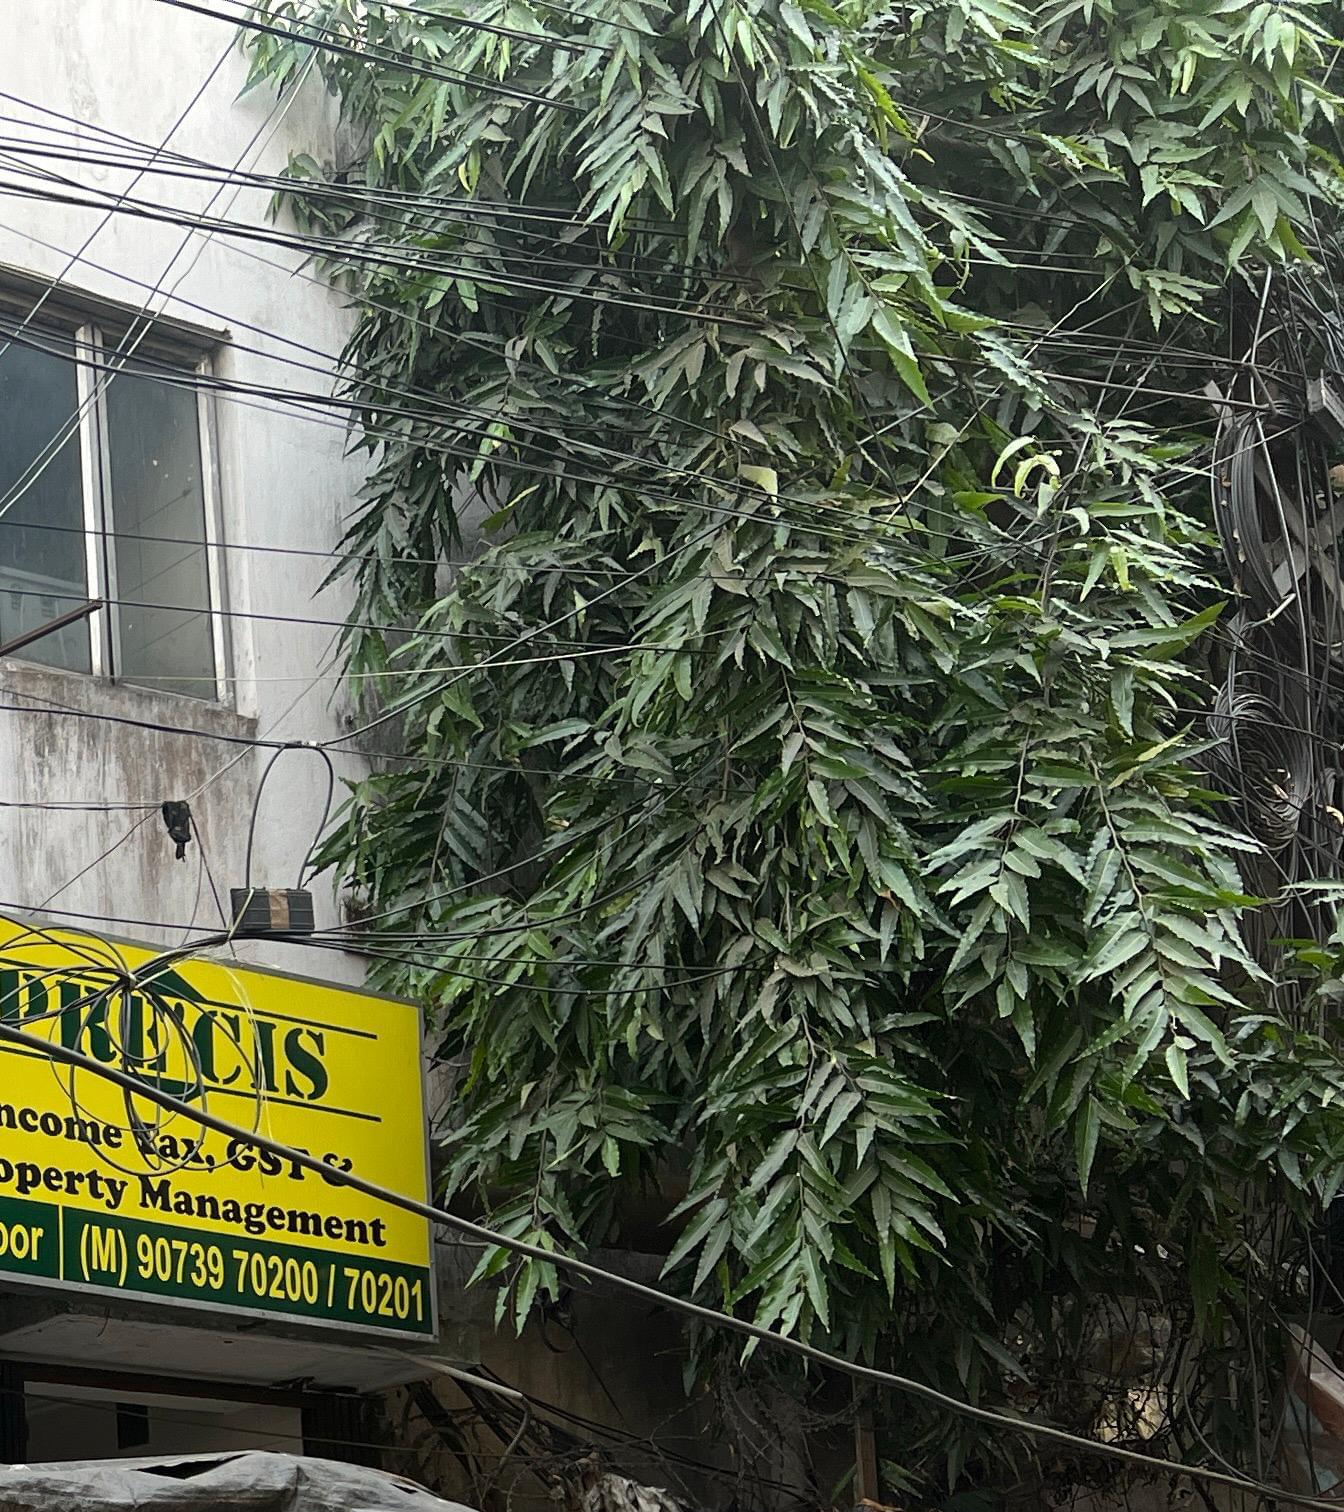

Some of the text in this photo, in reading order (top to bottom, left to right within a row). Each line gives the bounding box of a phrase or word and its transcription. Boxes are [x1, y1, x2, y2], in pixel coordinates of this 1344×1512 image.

[138, 1175, 387, 1247] Management
[80, 1224, 128, 1287] (M)
[136, 1234, 226, 1290] 90739
[237, 1247, 319, 1306] 70200
[345, 1267, 424, 1323] 70201
